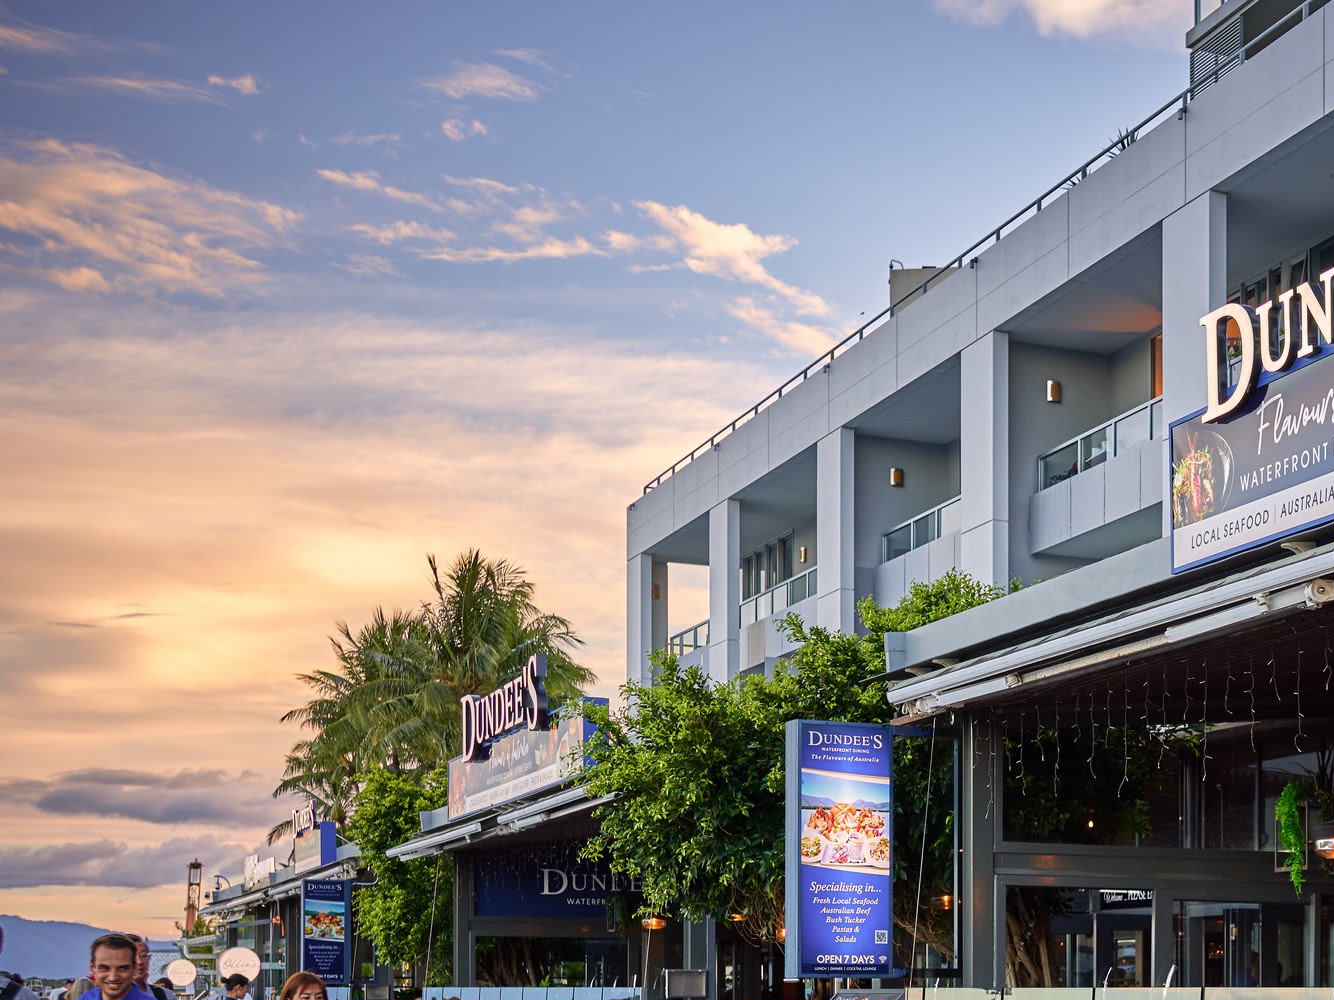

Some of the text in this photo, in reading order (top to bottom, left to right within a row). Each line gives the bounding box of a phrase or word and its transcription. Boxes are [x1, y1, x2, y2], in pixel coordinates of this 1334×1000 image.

[1239, 442, 1329, 492] WATERFRONT
[1191, 528, 1221, 550] LOCAL
[1223, 510, 1270, 539] SEAFOOD
[461, 653, 538, 763] DUNDEE'S
[808, 730, 883, 749] DUNDEE'S
[540, 868, 642, 895] DUNDE
[810, 881, 881, 894] Specialising in...
[567, 898, 606, 906] WATERFR
[832, 897, 851, 905] Local
[852, 898, 879, 906] Seafood
[820, 906, 855, 914] Australian
[816, 955, 875, 964] OPEN 7 DAYS
